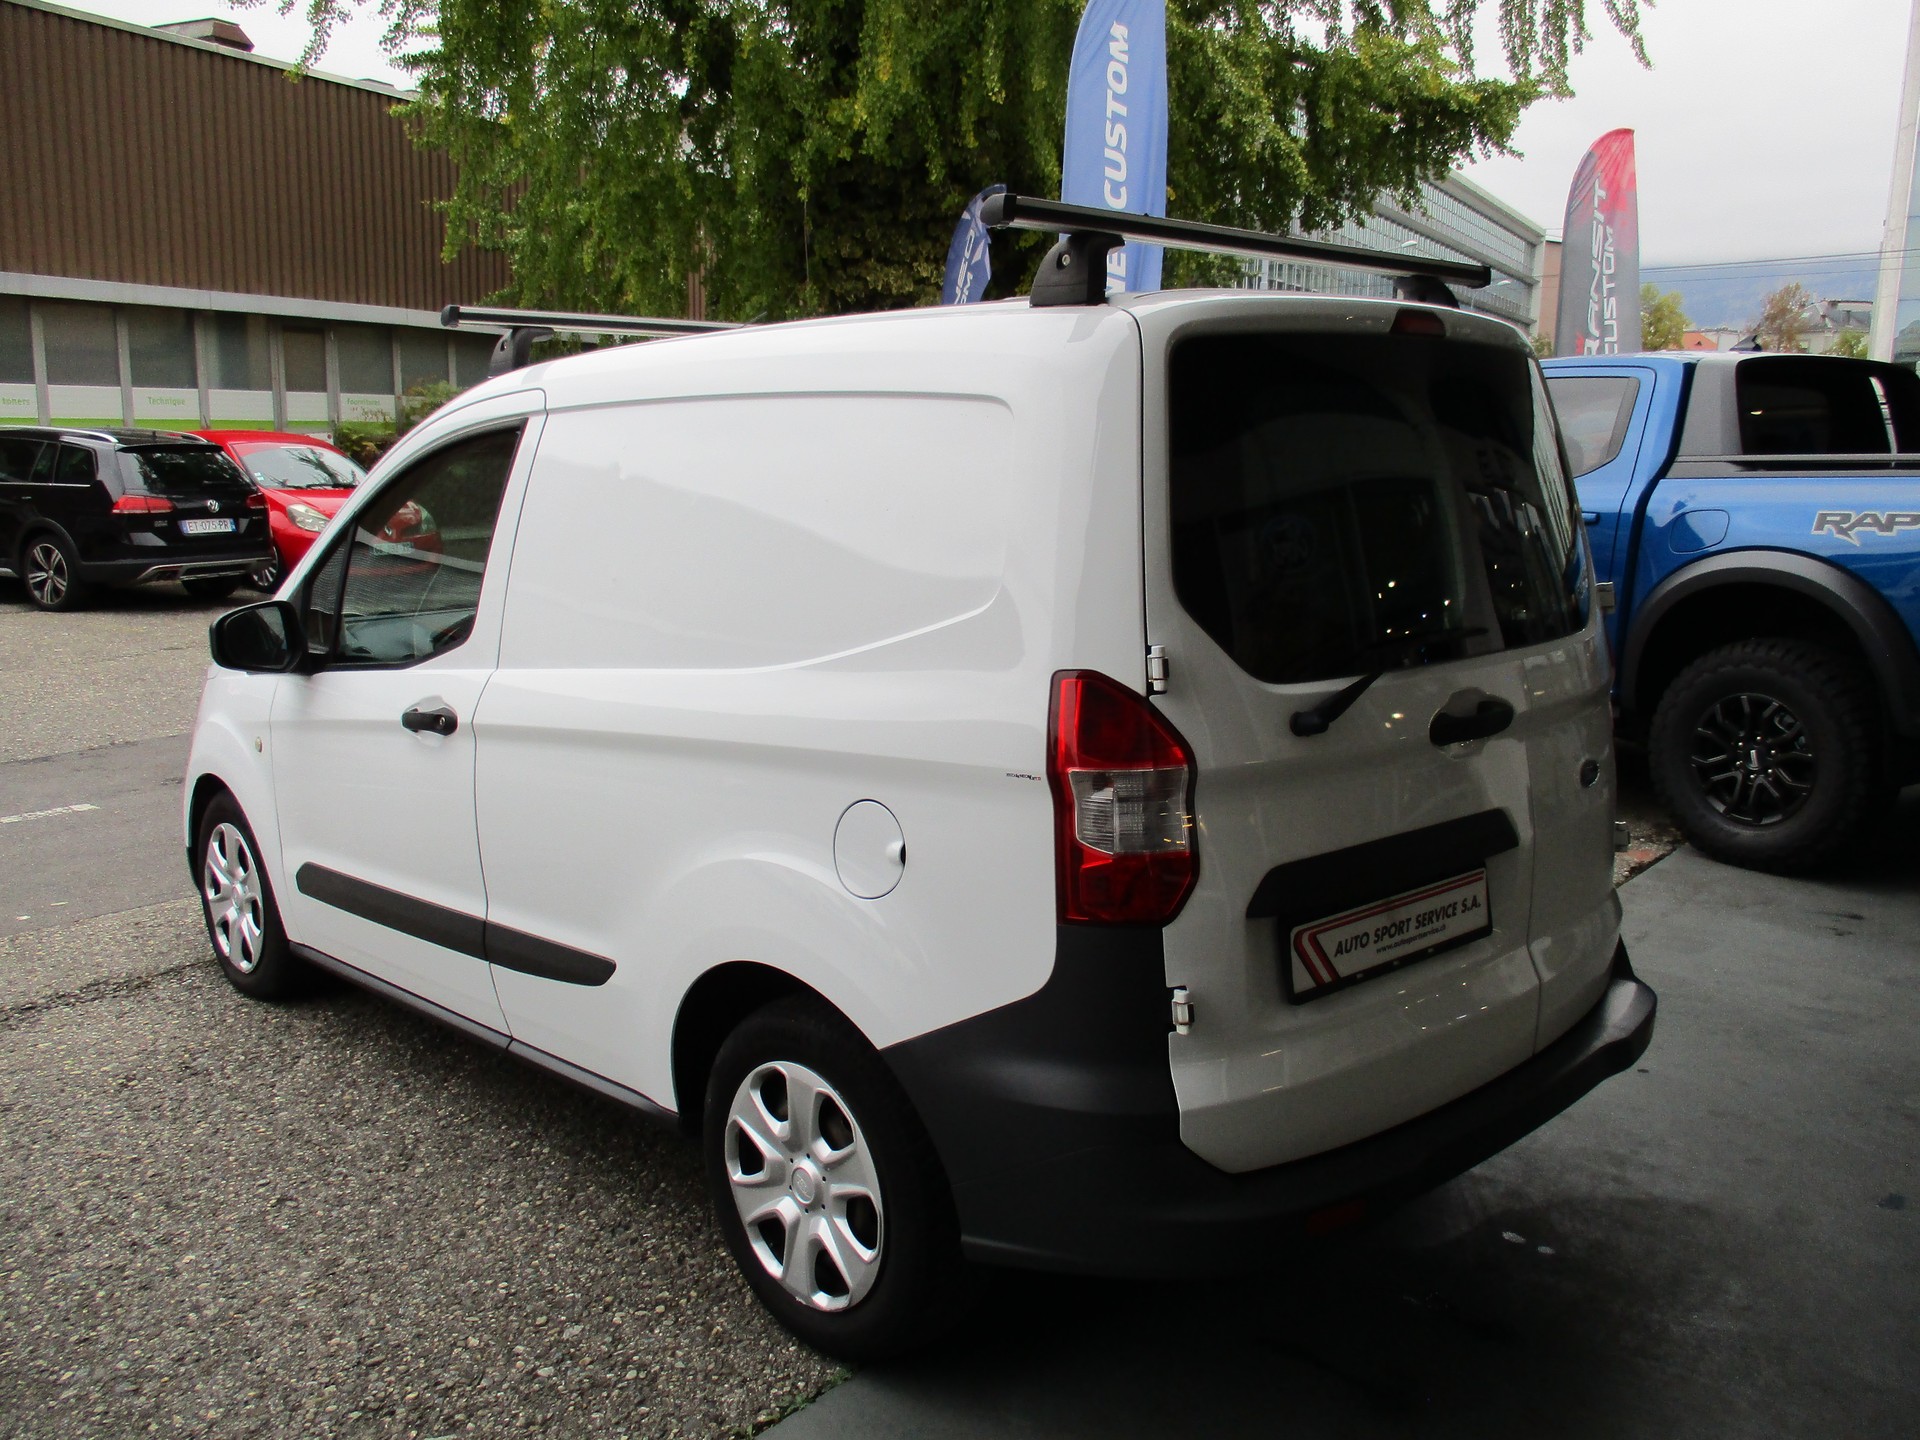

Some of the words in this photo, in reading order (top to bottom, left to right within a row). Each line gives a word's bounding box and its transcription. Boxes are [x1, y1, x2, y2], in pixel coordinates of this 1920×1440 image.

[1104, 21, 1128, 210] CUSTOM
[147, 396, 186, 407] Technique
[1811, 511, 1920, 546] RAP
[1334, 932, 1370, 957] AUTO
[1373, 917, 1411, 944] SPORT
[1415, 902, 1458, 929] SERVICE
[1461, 895, 1481, 913] S.A.
